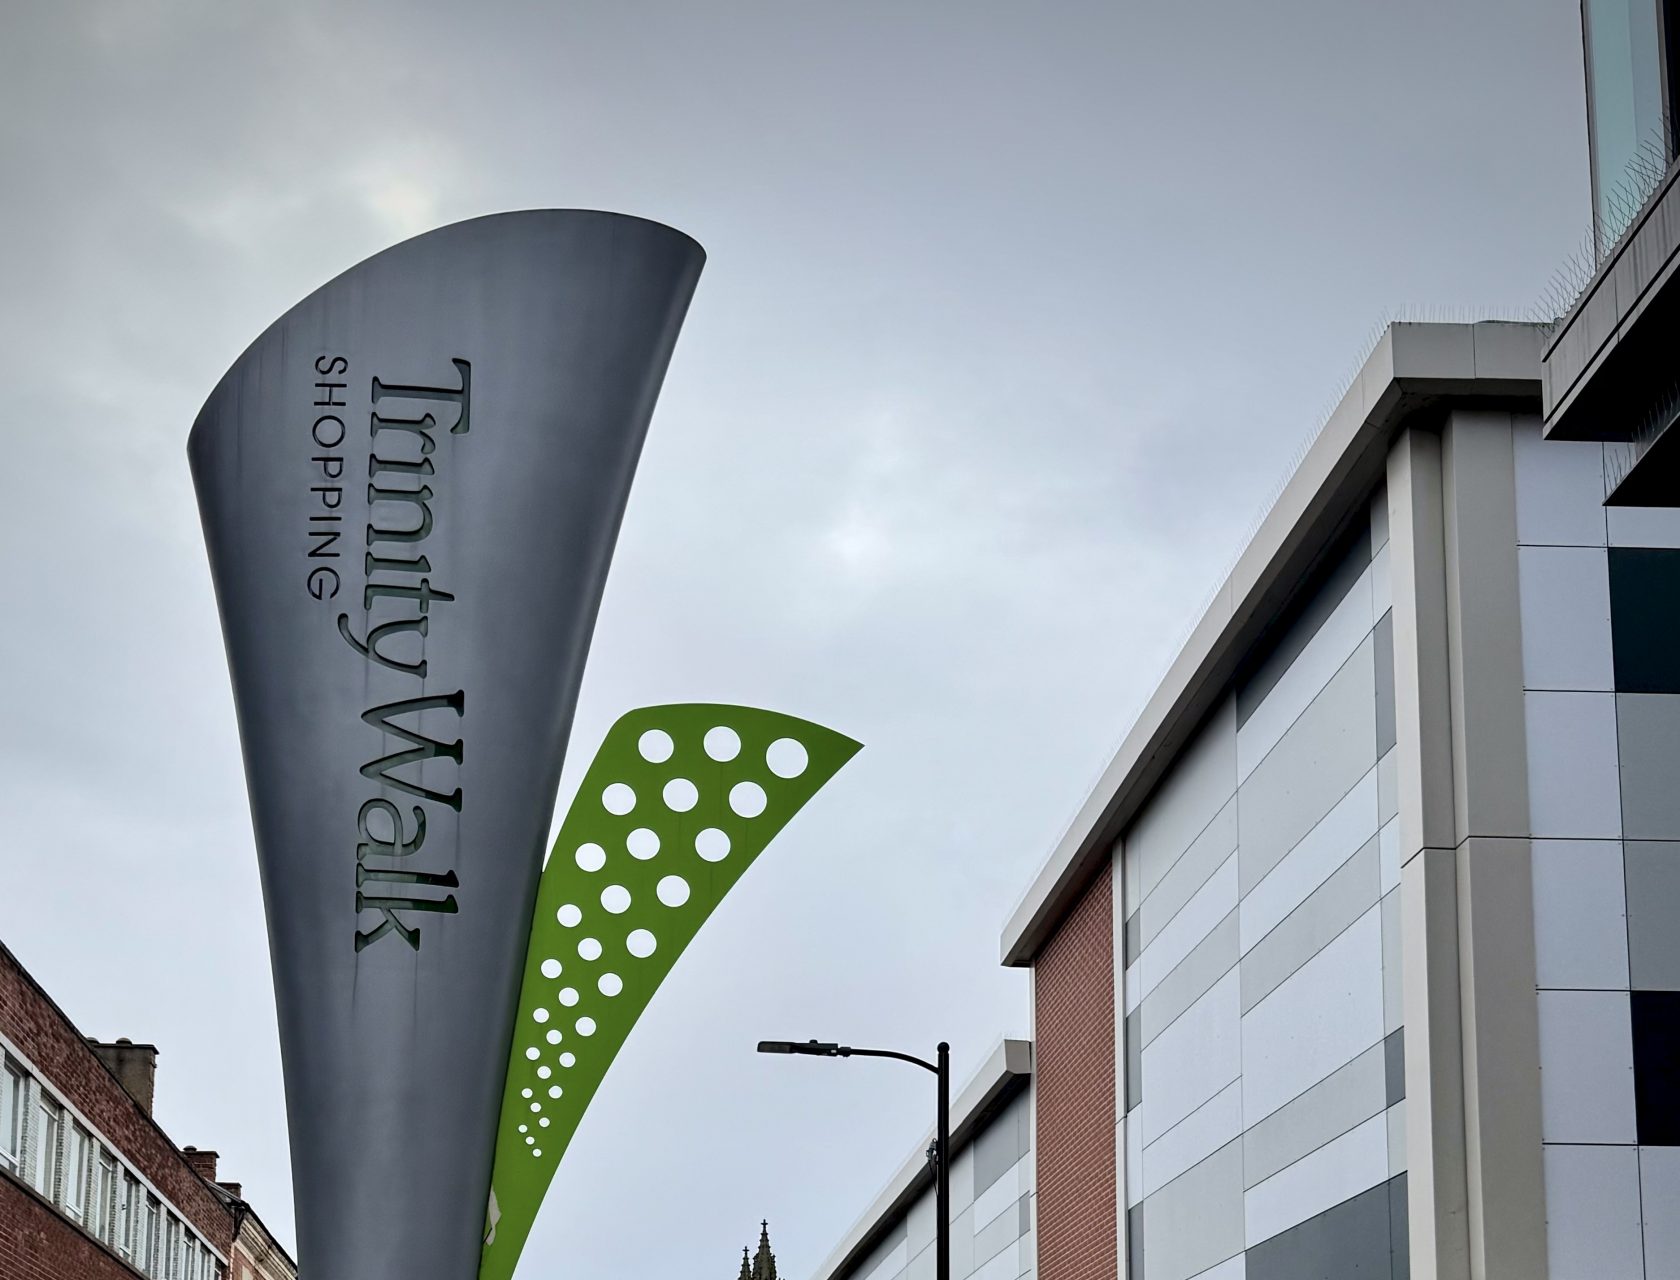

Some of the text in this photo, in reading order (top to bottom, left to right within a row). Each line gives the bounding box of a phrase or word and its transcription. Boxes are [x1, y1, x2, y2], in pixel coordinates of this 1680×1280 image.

[306, 354, 349, 601] SHOPPING
[337, 356, 472, 954] Trinity Walk
